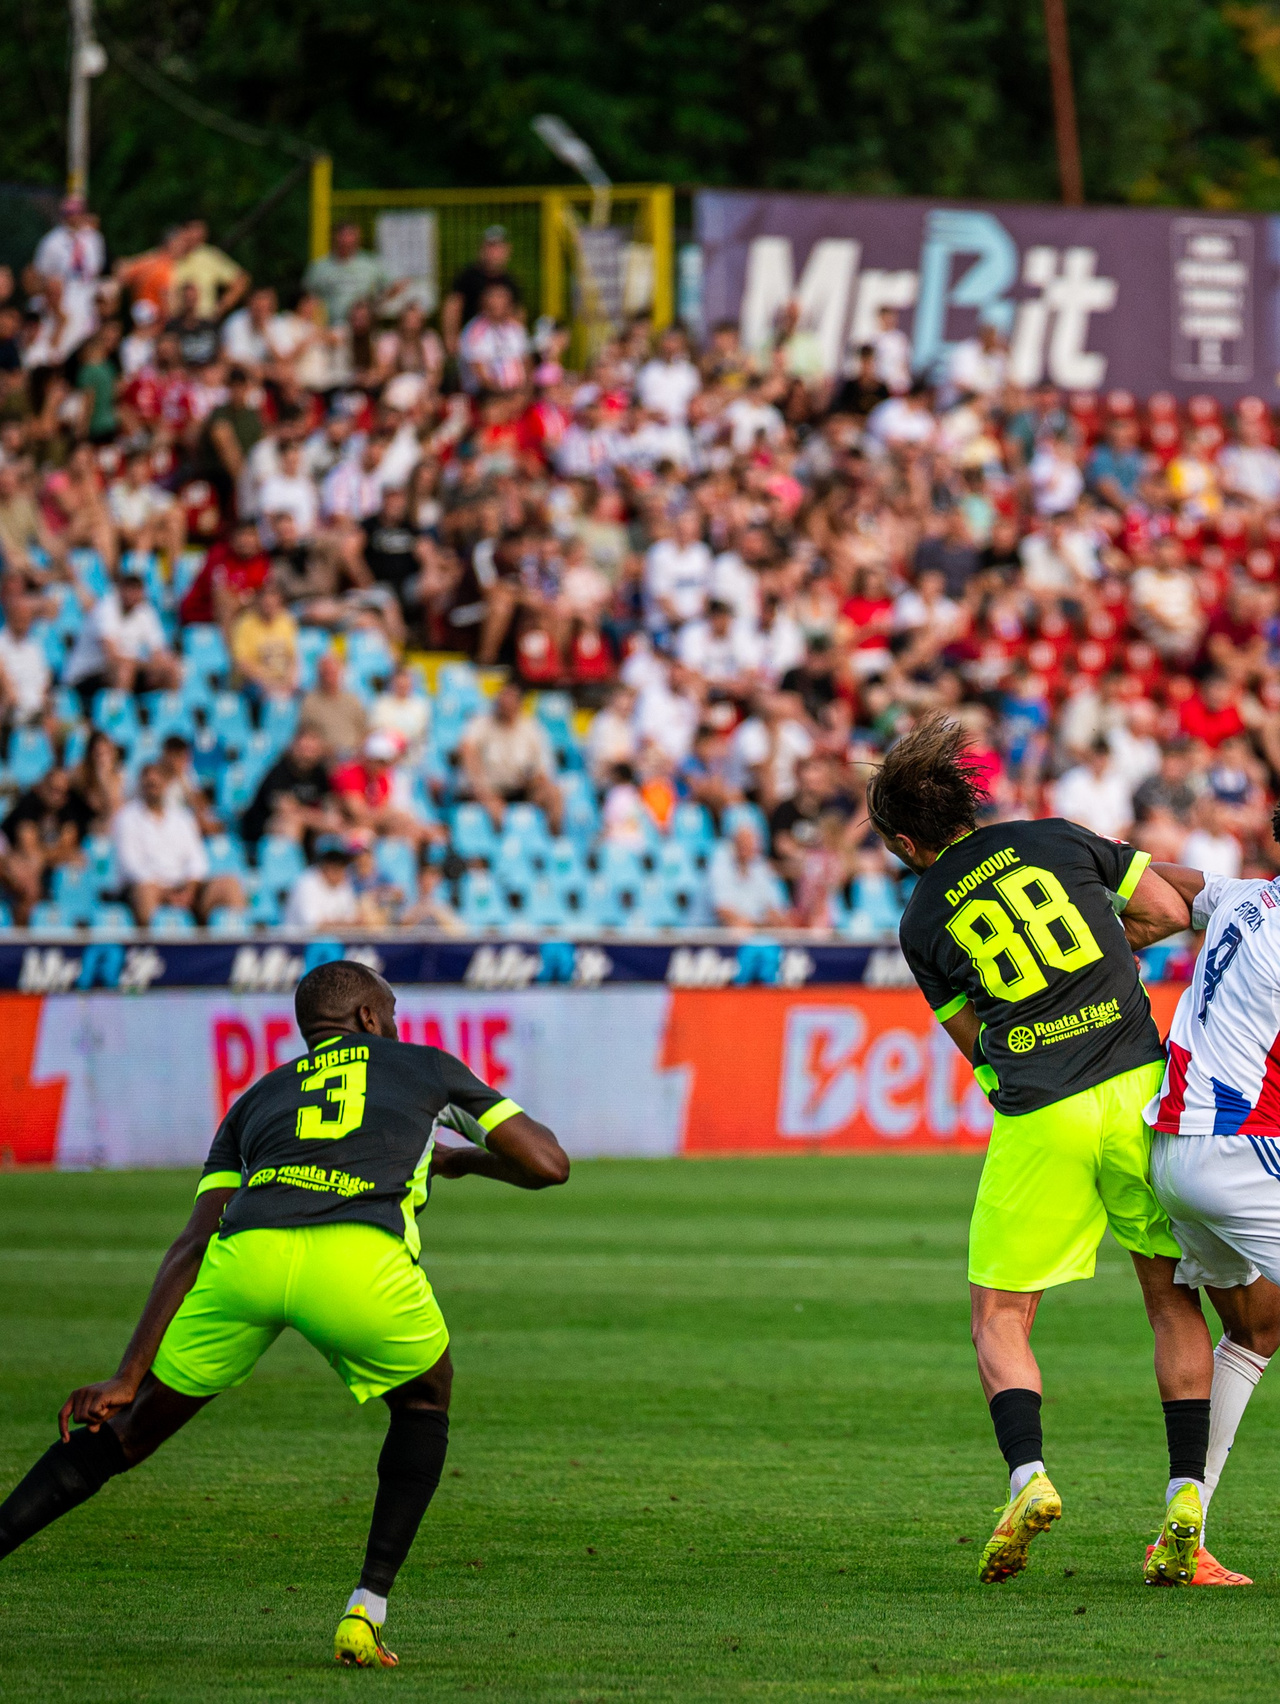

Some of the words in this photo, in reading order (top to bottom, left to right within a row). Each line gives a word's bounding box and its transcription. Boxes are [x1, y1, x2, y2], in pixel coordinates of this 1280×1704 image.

[738, 208, 1118, 392] MrBit
[944, 847, 1020, 907] DJOKOVIC
[945, 865, 1104, 1002] 88
[1034, 1014, 1079, 1037] Roata
[1079, 998, 1120, 1022] Făget
[1042, 1025, 1089, 1046] restaurant
[295, 1060, 367, 1140] 3
